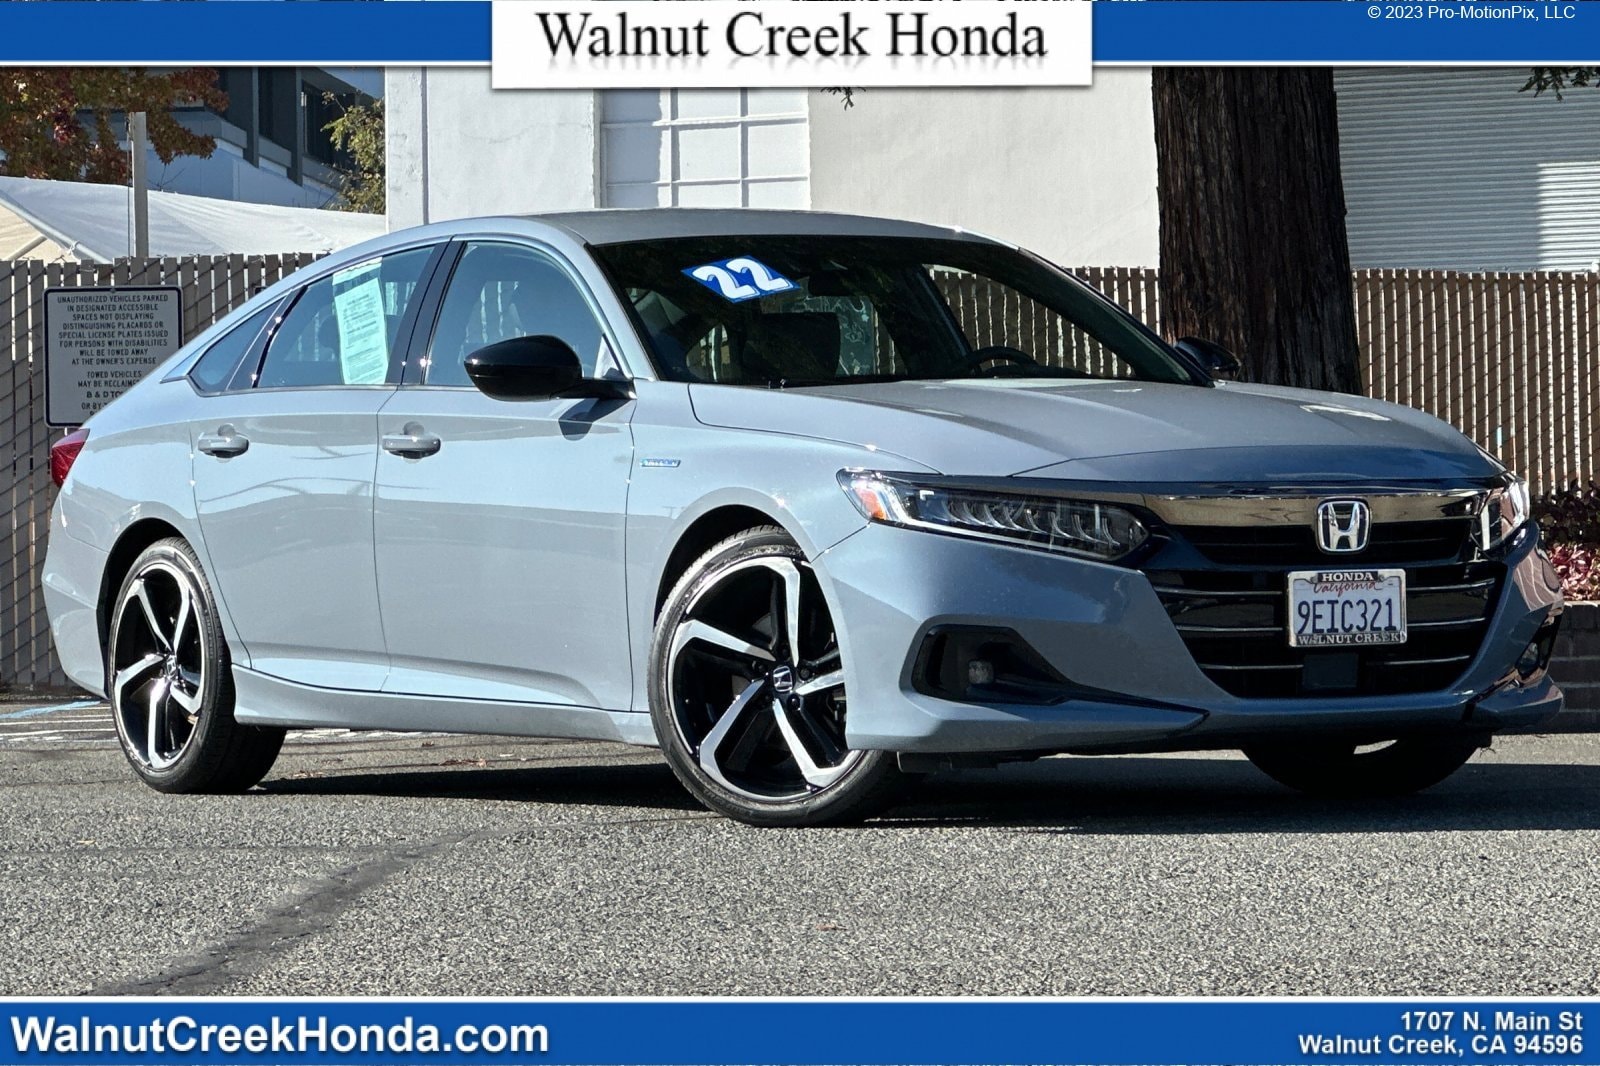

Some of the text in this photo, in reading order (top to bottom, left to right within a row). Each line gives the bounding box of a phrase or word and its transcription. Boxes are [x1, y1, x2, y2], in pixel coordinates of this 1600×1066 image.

[692, 257, 795, 299] 22
[57, 294, 169, 304] UNAUTHORIZED VEHICLES PARKED
[67, 303, 159, 312] IN DESIGNATED ACCESSIBLE
[72, 312, 154, 321] SPACES NOT DISPLAYING
[62, 322, 116, 330] DISTINGUISHING
[117, 321, 153, 329] PLACARDS
[58, 331, 86, 339] SPECIAL
[88, 331, 115, 339] LICENSE
[117, 330, 143, 338] PLATES
[59, 339, 168, 348] FOR PERSONS WITH DISABILITIES
[79, 349, 94, 357] WILL
[107, 348, 129, 356] TOWED
[131, 348, 149, 356] AWAY
[81, 357, 94, 365] THE
[96, 357, 125, 365] OWNER'S
[126, 356, 157, 365] EXPENSE
[87, 370, 142, 379] TOWED VEHICLES
[78, 380, 92, 388] MAY
[104, 379, 140, 387] RECLAIME
[81, 402, 91, 410] OR
[1321, 572, 1374, 582] HONDA
[1297, 598, 1397, 635] 9EIC321
[1298, 632, 1400, 645] WALNUT CREEK
